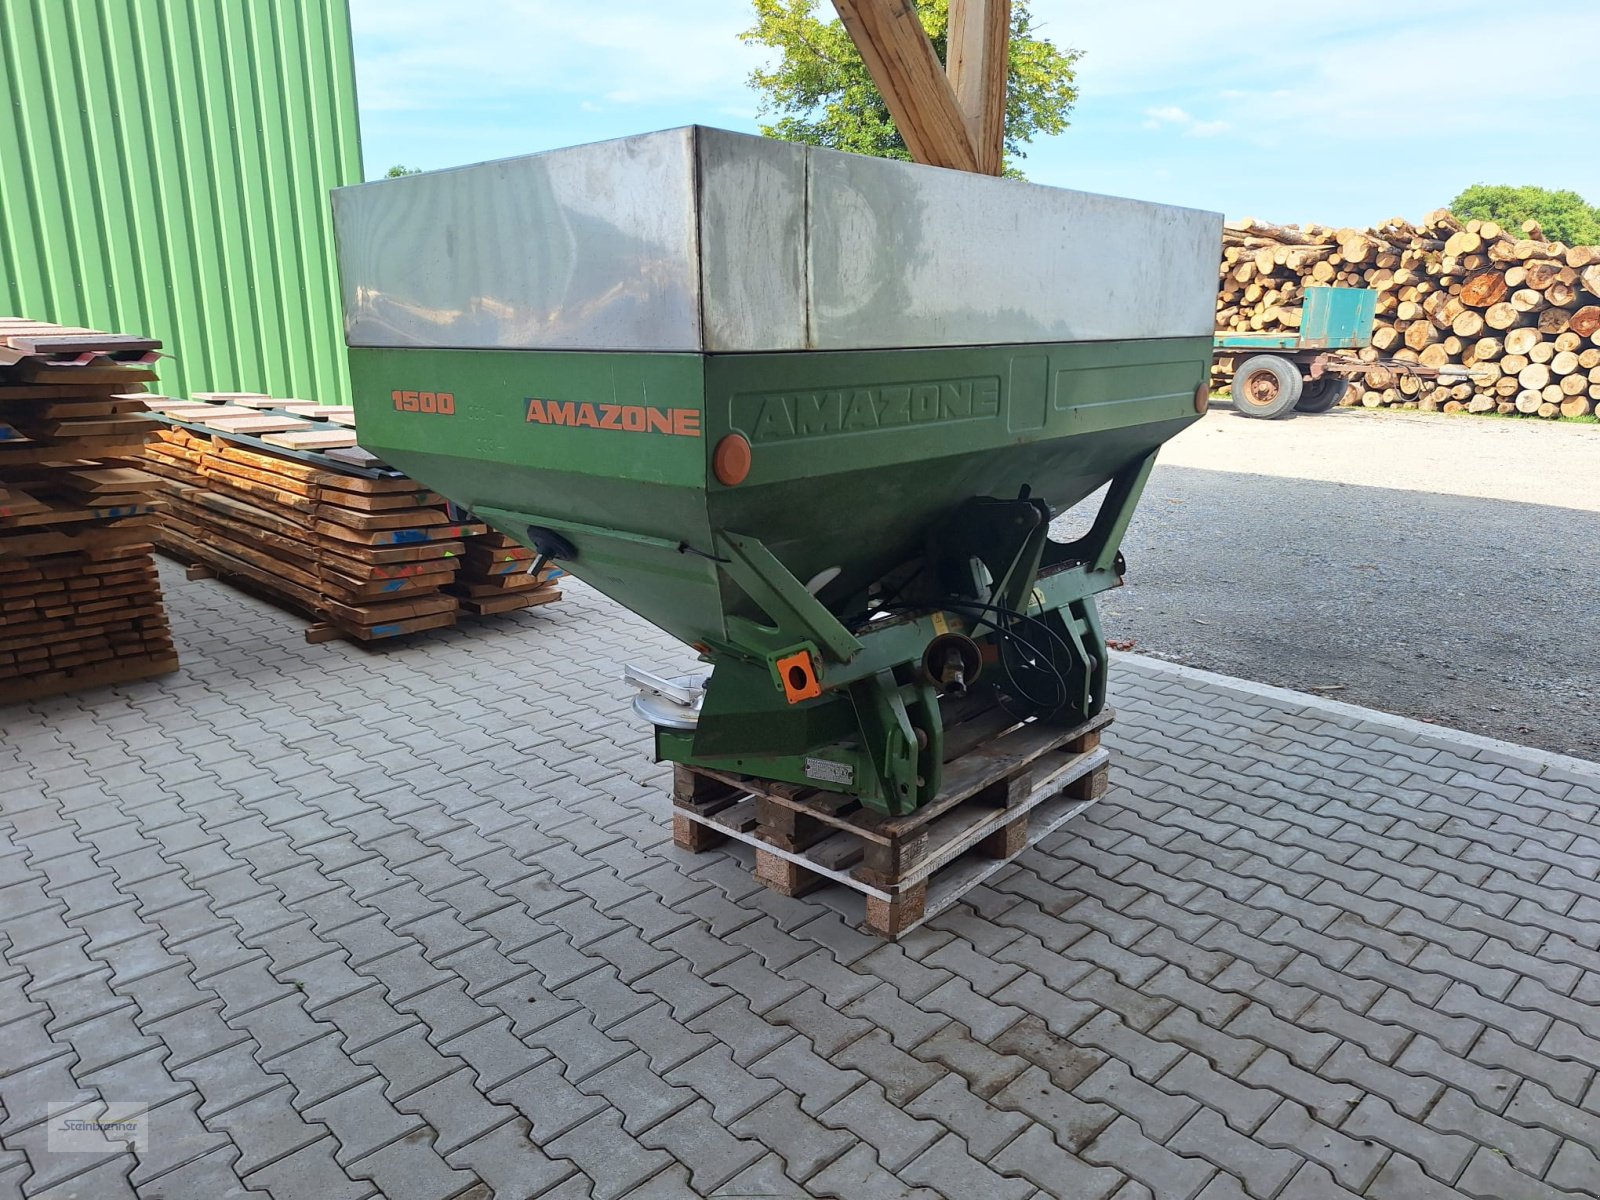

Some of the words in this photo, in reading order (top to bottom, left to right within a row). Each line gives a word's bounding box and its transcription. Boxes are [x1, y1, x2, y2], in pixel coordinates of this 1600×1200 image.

[392, 390, 455, 415] 1500
[526, 399, 701, 437] AMAZONE
[751, 378, 997, 440] AMAZONE
